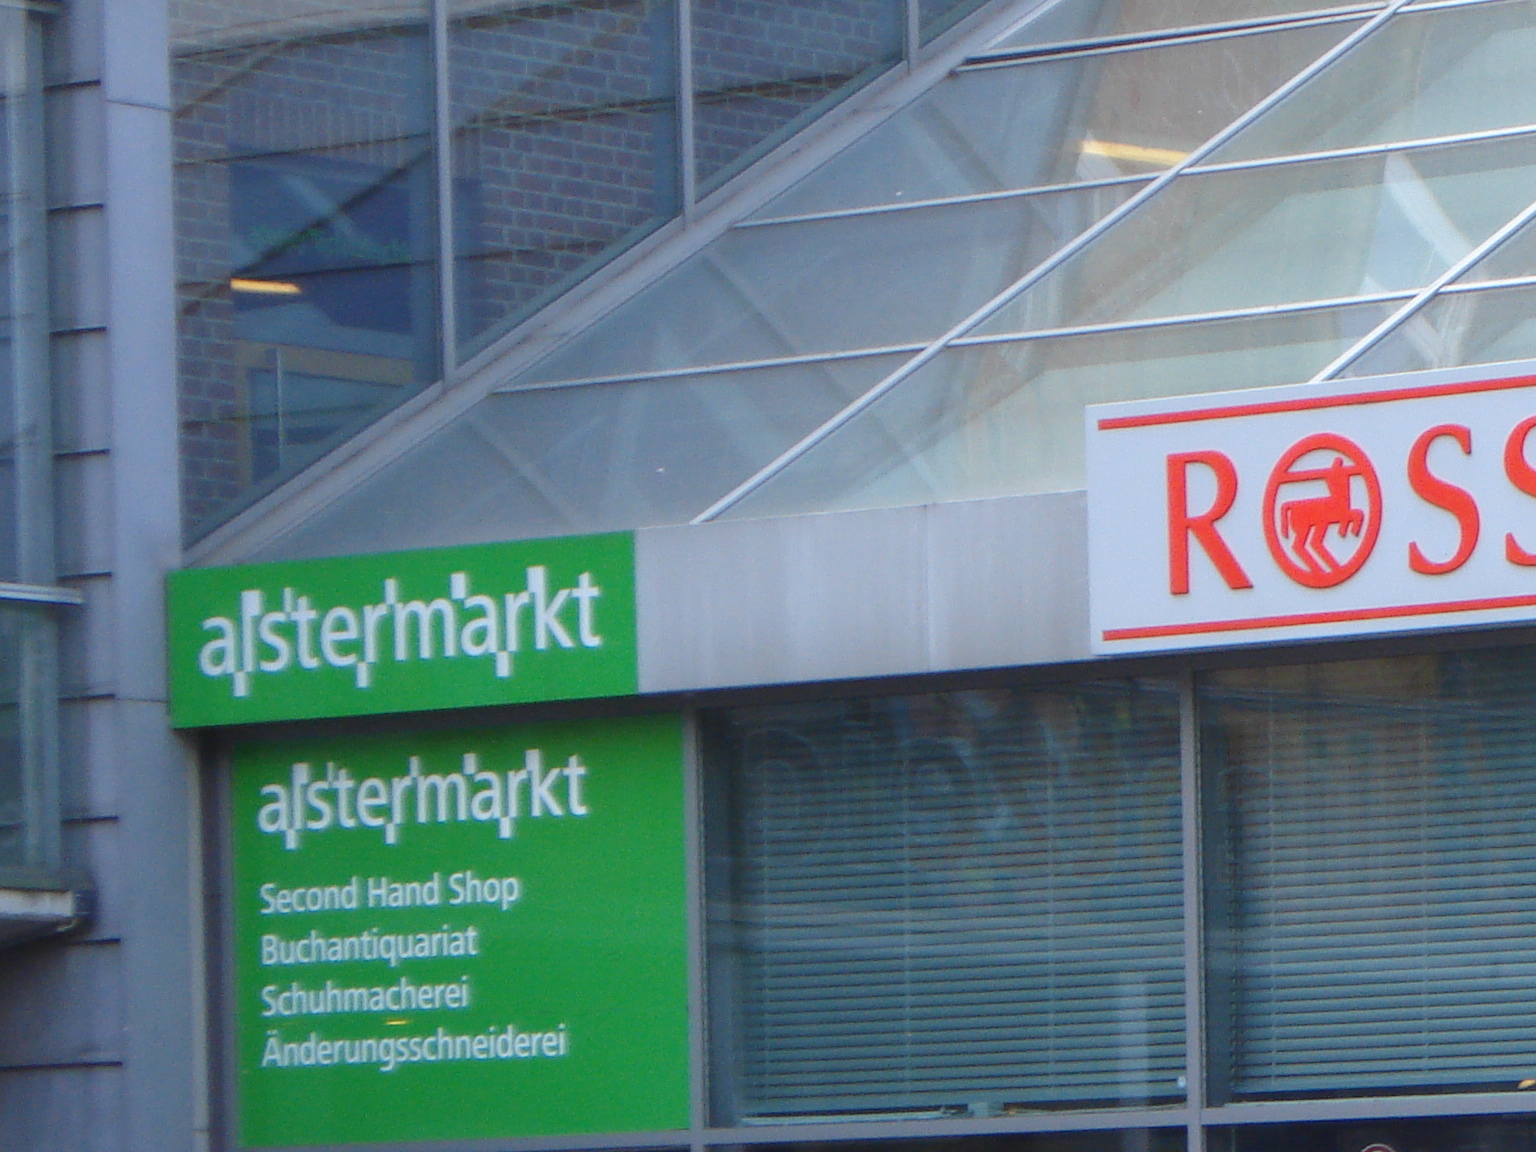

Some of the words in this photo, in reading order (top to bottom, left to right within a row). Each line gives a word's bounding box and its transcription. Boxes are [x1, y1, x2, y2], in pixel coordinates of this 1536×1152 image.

[199, 565, 603, 697] alstermarkt
[257, 748, 589, 851] alstermarkt
[260, 876, 357, 915] Second
[367, 874, 440, 909] Hand
[448, 871, 520, 910] Shop
[260, 925, 480, 967] Buchantiquariat
[260, 976, 470, 1017] Schuhmacherei
[261, 1023, 568, 1072] Änderungsschneiderei
